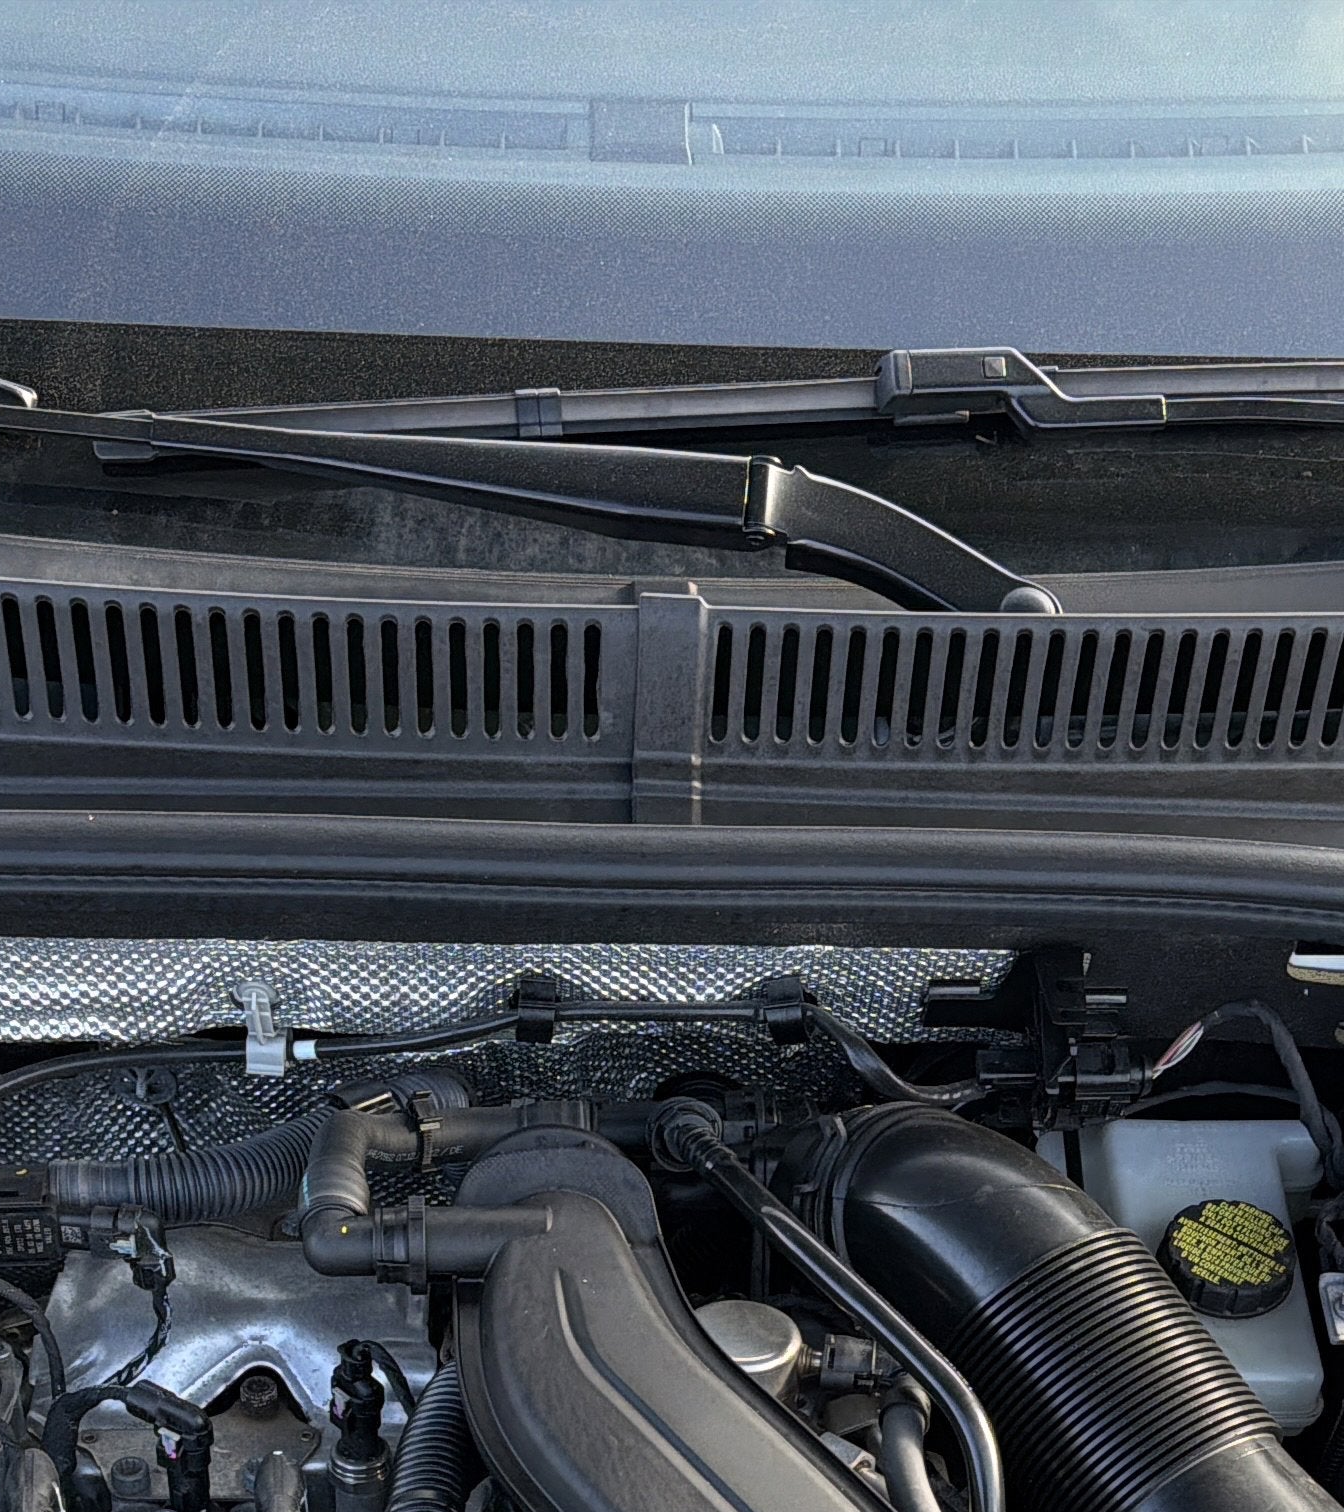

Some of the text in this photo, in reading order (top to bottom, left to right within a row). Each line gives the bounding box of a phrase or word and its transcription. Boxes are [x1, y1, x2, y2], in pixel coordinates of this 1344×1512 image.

[1204, 1202, 1234, 1219] BEFORE
[1273, 1235, 1290, 1246] USE
[1205, 1218, 1233, 1235] SEALED
[1219, 1201, 1284, 1236] CLEAN FILLER CAP
[1201, 1208, 1222, 1221] ONLY
[1220, 1217, 1236, 1229] DOT
[1240, 1227, 1263, 1242] FLUID
[1262, 1238, 1284, 1252] FROM
[1215, 1242, 1240, 1258] AVANT
[1241, 1255, 1252, 1264] DE
[1242, 1264, 1259, 1276] QUE
[1258, 1272, 1272, 1282] DU
[1274, 1263, 1286, 1272] LE
